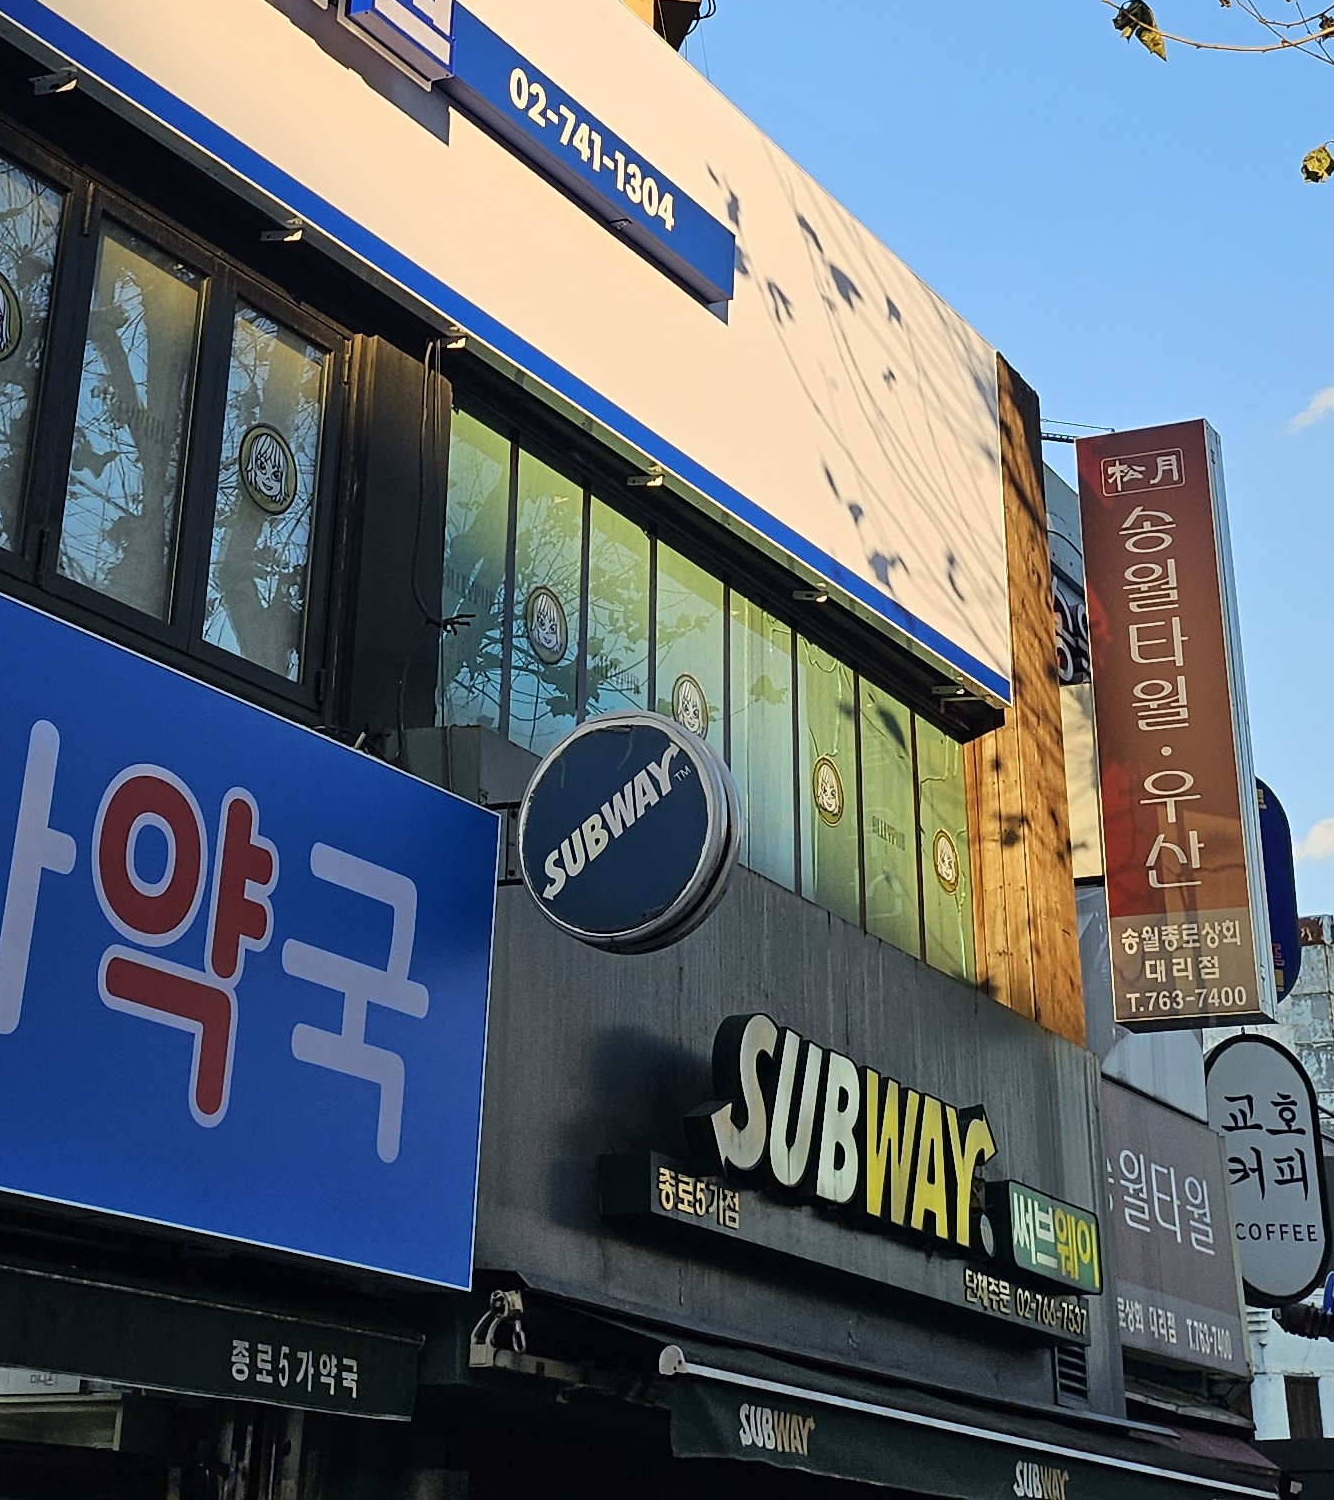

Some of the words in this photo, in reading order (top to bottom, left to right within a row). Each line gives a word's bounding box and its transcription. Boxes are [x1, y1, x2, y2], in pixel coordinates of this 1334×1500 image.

[506, 64, 677, 231] 02-741-1304
[1105, 452, 1183, 492] 松月
[541, 741, 681, 901] SUBWAY
[1120, 917, 1241, 955] 송월종로상회
[1144, 954, 1221, 984] 대리점
[1125, 985, 1248, 1014] T.763-7400
[710, 1012, 998, 1249] SUBWAY
[1221, 1092, 1307, 1137] 교호
[657, 1166, 740, 1230] 종로5가점
[1106, 1148, 1216, 1257] 월타월
[1228, 1146, 1310, 1202] 커피
[1011, 1190, 1102, 1290] 써브웨이
[1234, 1222, 1319, 1243] COFFEE
[963, 1266, 1011, 1315] 단체주문
[1015, 1287, 1089, 1336] 02-766-7537
[229, 1337, 359, 1399] 종로5가약국
[738, 1402, 816, 1457] SUBWAY
